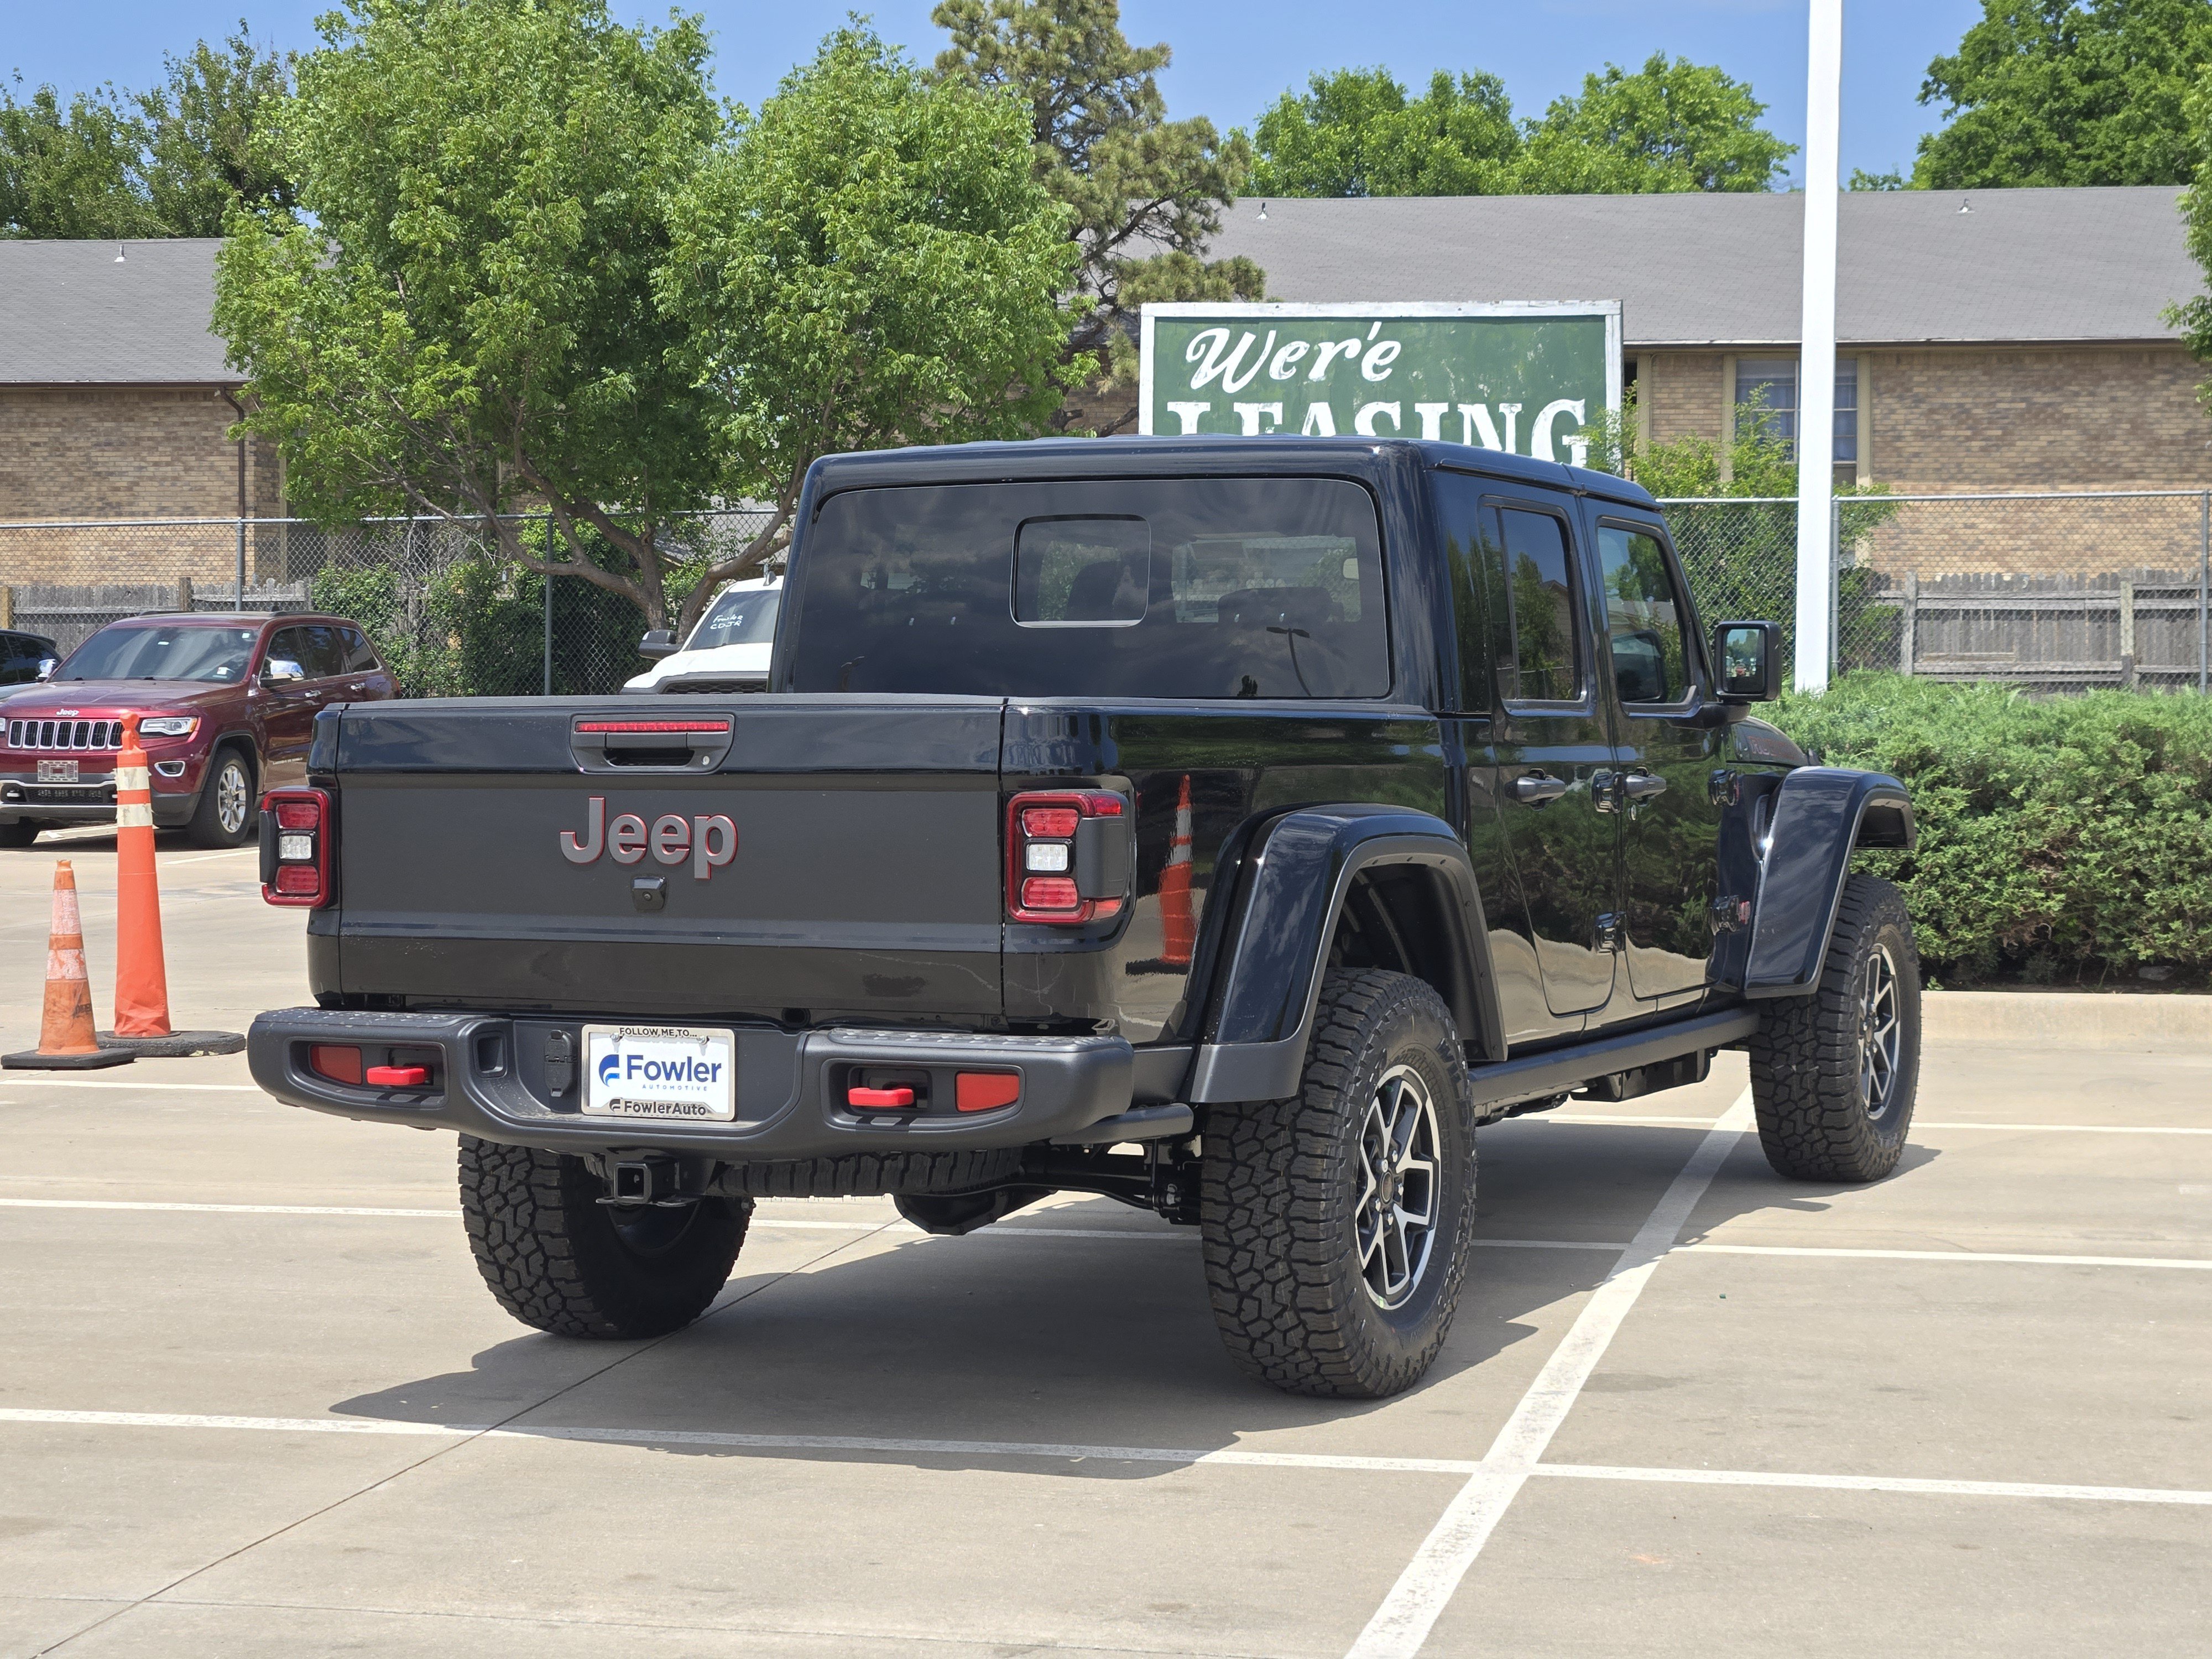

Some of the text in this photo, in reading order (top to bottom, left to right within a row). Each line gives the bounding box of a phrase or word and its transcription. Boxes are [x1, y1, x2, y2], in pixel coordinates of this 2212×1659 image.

[710, 620, 742, 630] CDJR
[56, 708, 80, 717] Jeep
[560, 796, 739, 880] Jeep
[627, 1054, 722, 1083] Fowler
